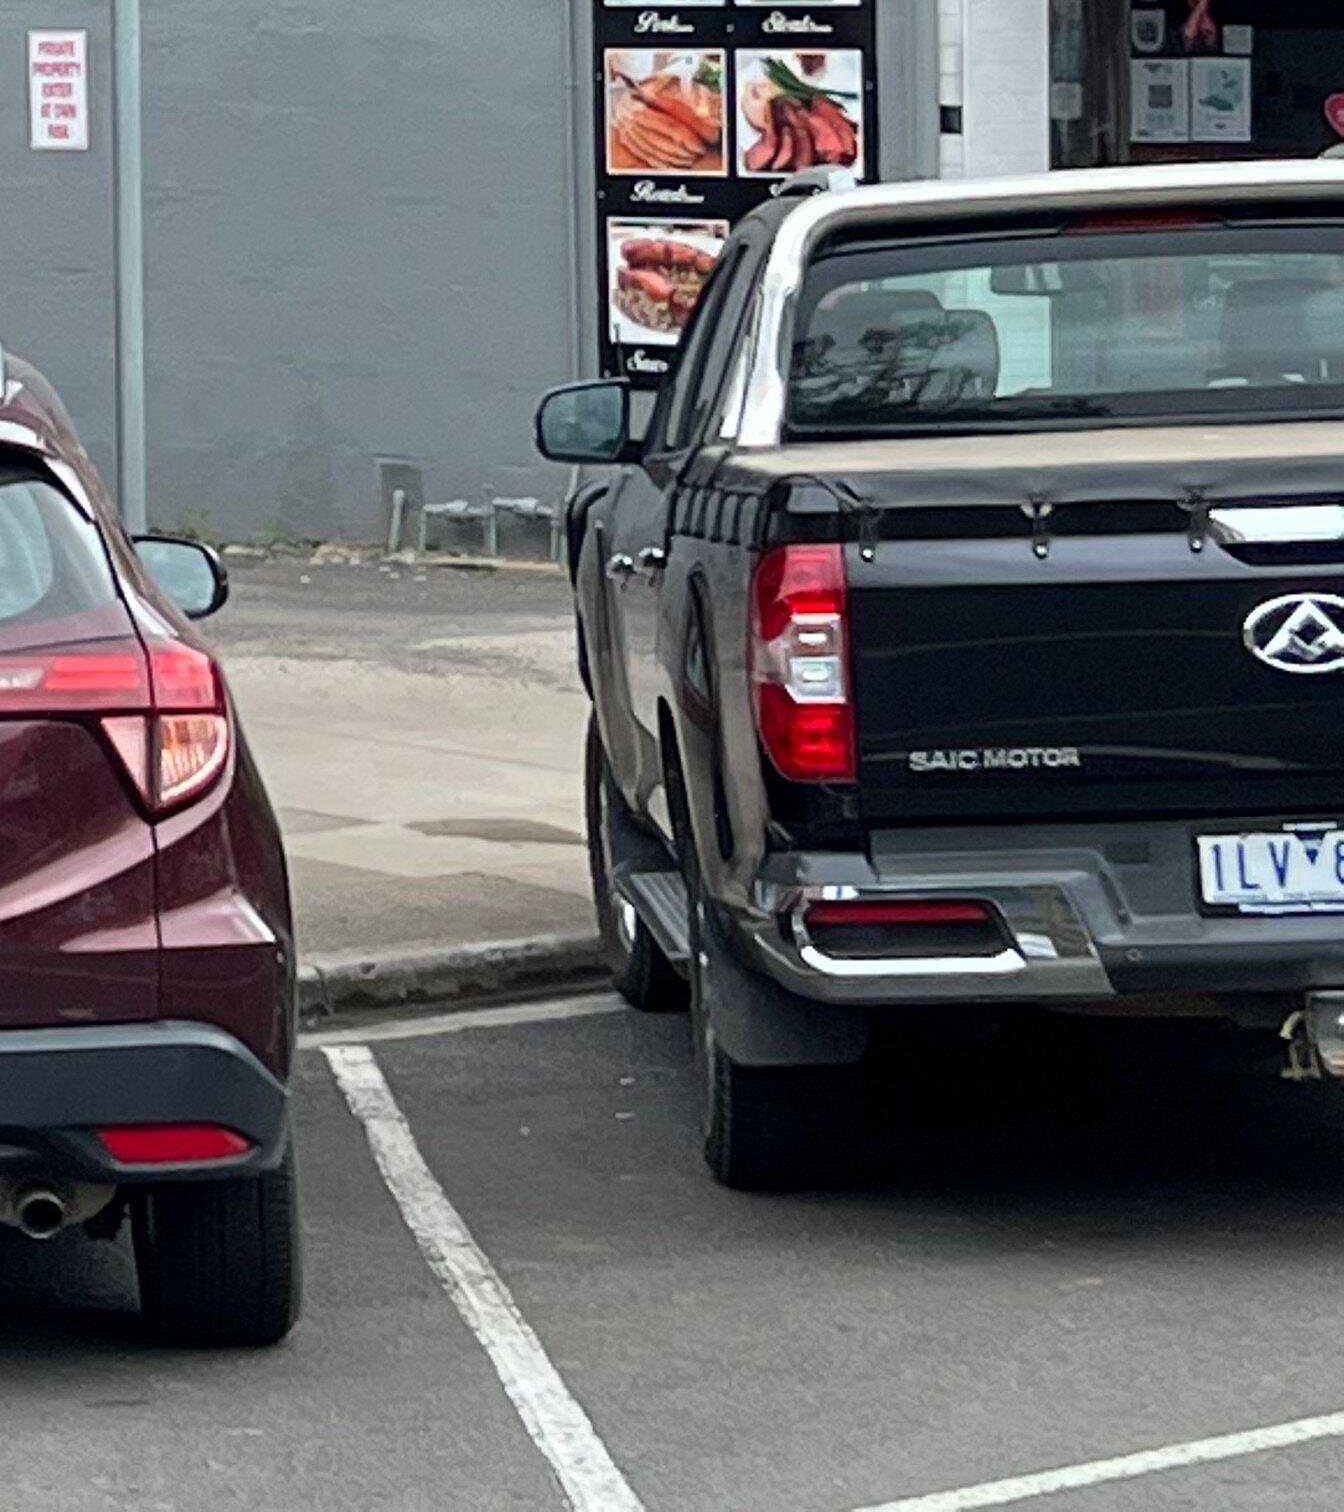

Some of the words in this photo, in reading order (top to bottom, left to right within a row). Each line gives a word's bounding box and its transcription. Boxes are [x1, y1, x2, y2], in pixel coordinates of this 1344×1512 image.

[909, 750, 979, 771] SAIC
[983, 746, 1080, 769] MOTOR
[1211, 840, 1290, 891] 1LV
